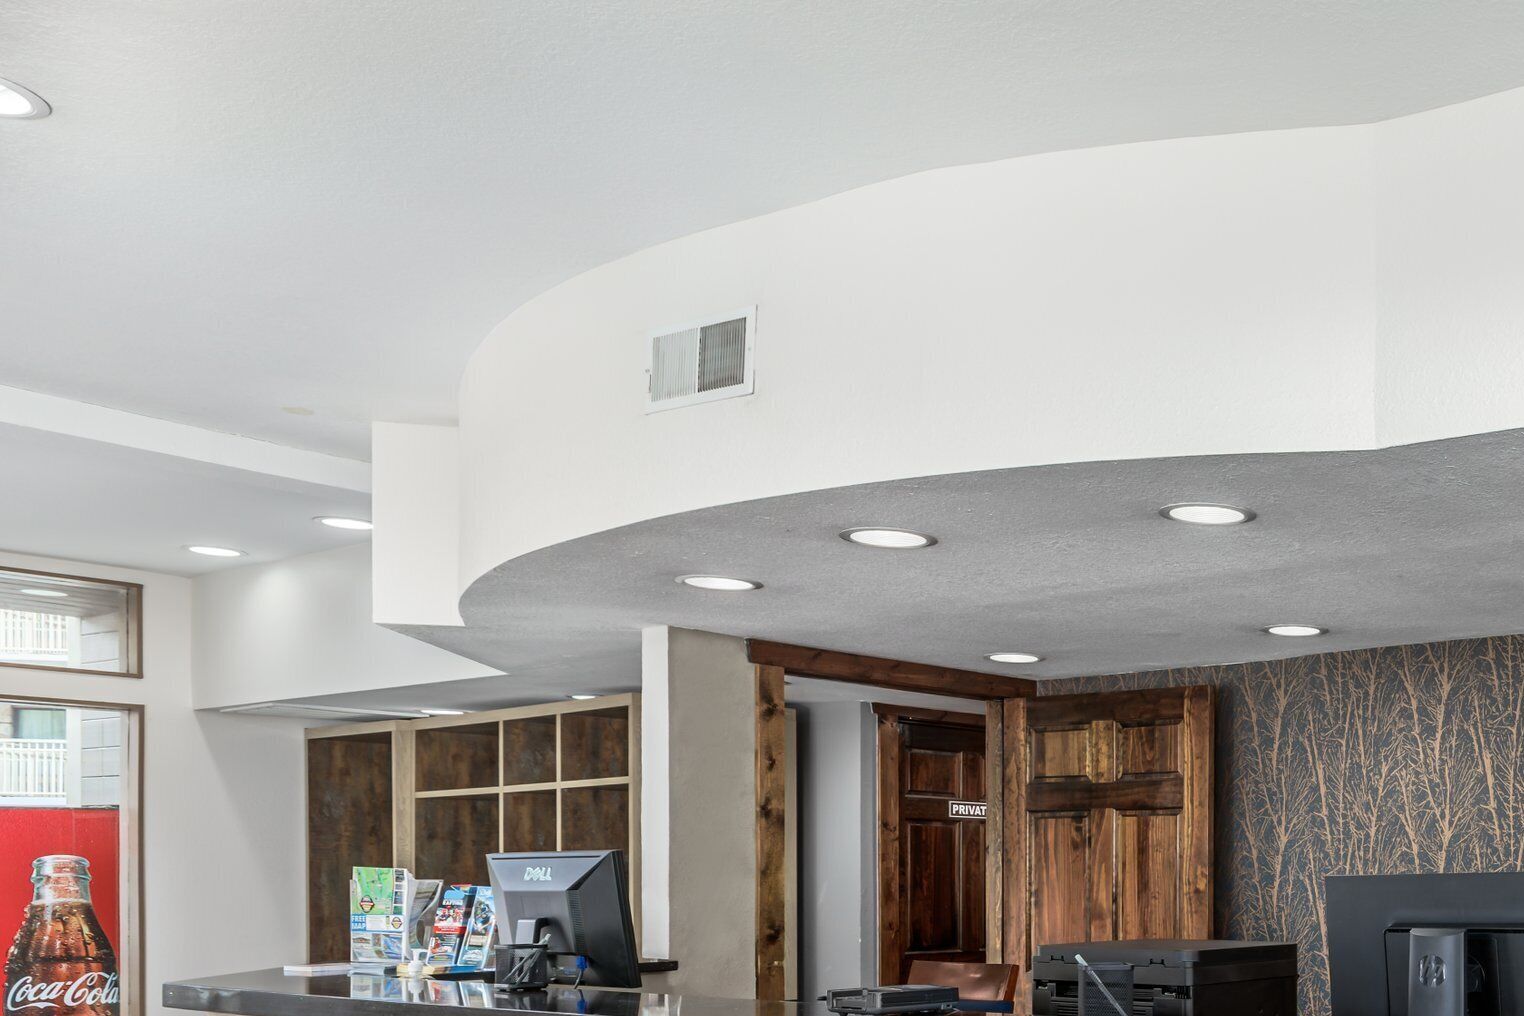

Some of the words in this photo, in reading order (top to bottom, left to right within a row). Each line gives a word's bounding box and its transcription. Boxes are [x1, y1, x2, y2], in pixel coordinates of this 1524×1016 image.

[952, 804, 987, 816] PRIVAT
[523, 866, 552, 881] DELL
[7, 971, 119, 1011] Coca-Cola
